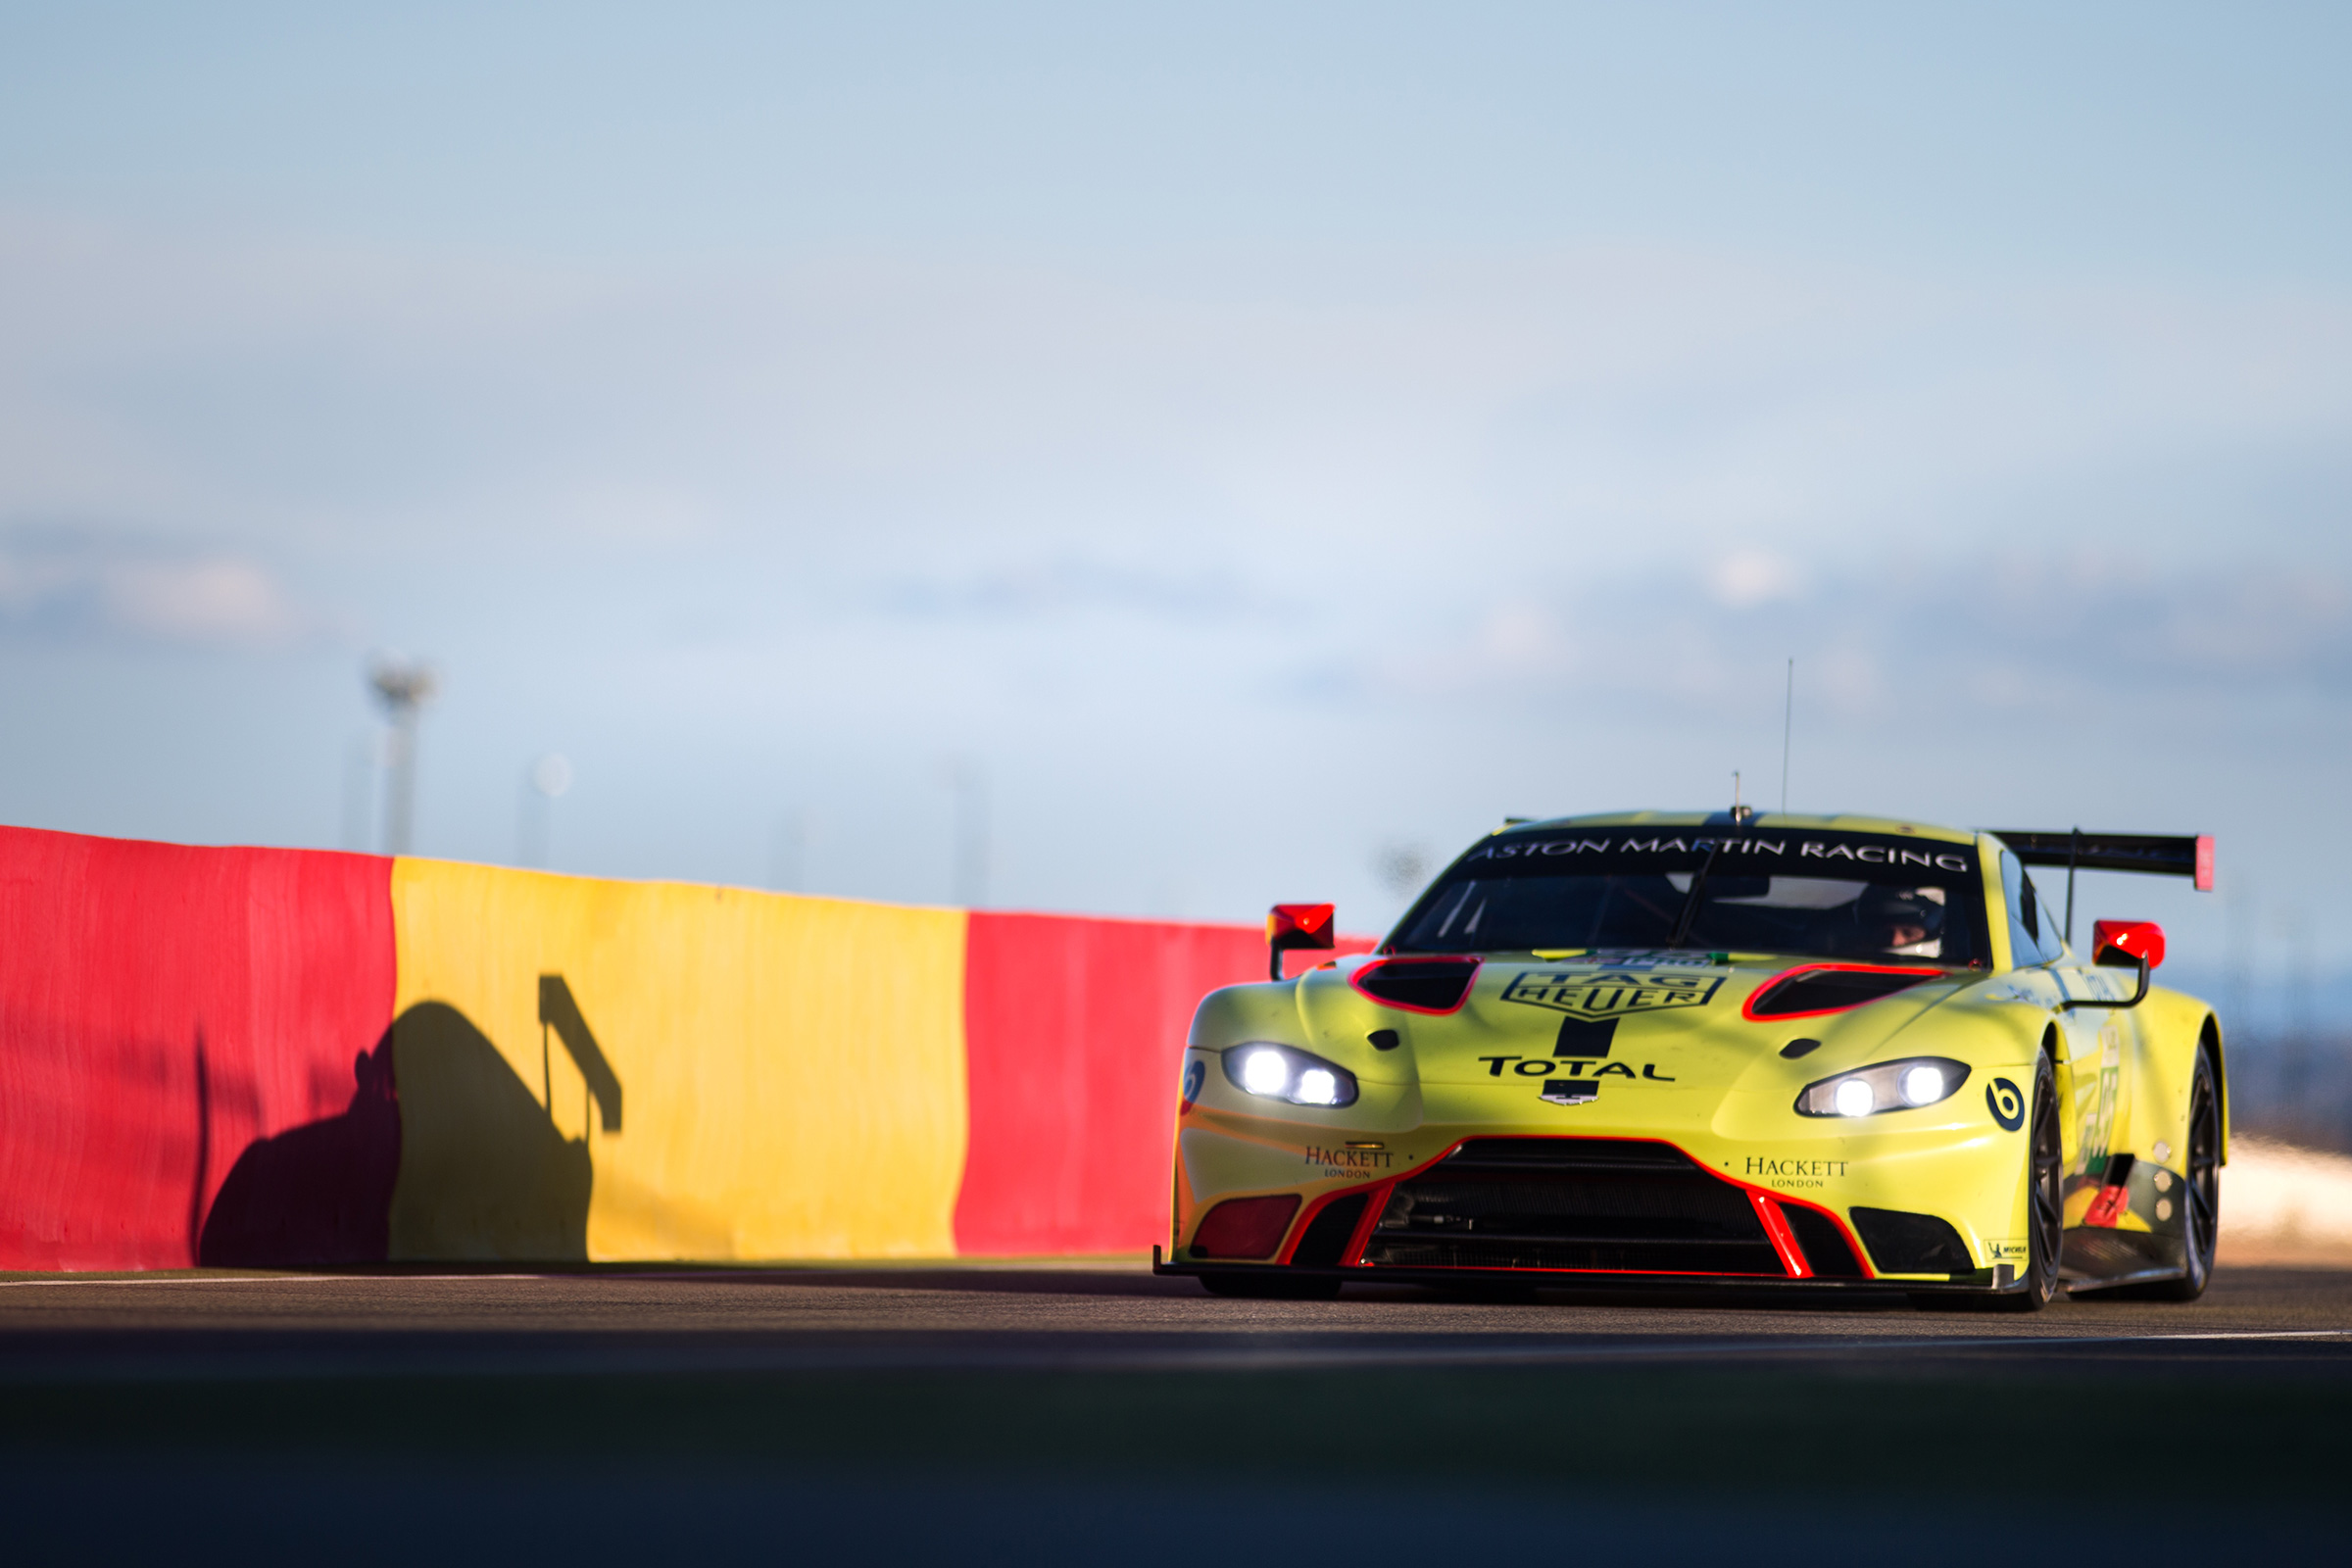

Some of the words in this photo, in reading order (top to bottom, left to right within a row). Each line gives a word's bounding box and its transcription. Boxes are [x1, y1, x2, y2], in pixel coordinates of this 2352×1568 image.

[1469, 837, 1610, 860] ASTON
[1620, 837, 1787, 856] MARTIN
[1801, 841, 1968, 873] RACING
[1538, 973, 1701, 988] TAG
[1518, 987, 1696, 1011] HEUER
[1478, 1055, 1676, 1082] TOTAL
[1305, 1146, 1394, 1167] HACKETT
[1745, 1156, 1849, 1177] HACKETT
[1324, 1168, 1370, 1179] LONDON
[1772, 1179, 1824, 1188] LONDON
